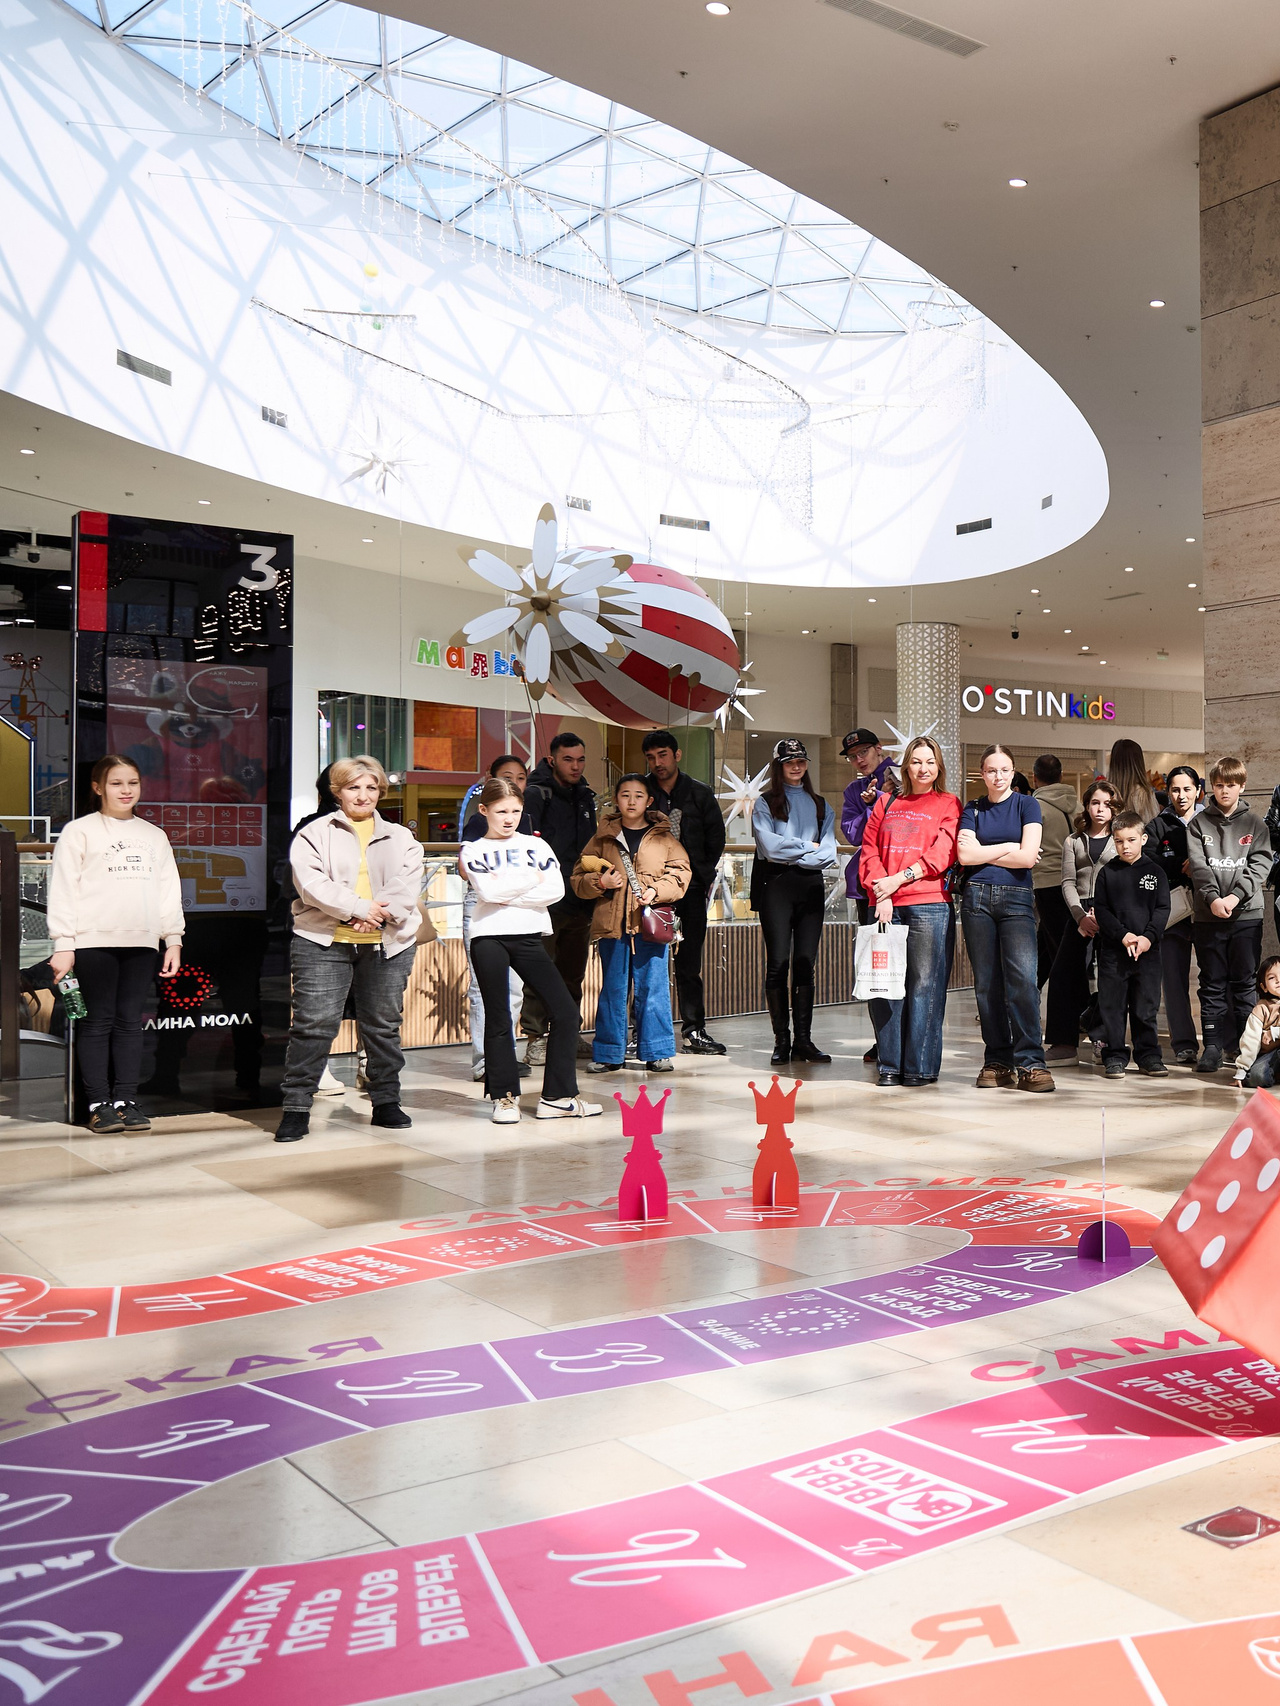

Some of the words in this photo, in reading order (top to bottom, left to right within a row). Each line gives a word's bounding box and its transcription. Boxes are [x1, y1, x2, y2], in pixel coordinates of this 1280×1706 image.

[238, 543, 279, 591] 3
[1144, 880, 1155, 890] 65
[961, 1193, 1035, 1217] СДЕЛАЙ
[265, 1265, 359, 1289] СДЕЛАЙ
[341, 1253, 418, 1275] НАЗАД
[972, 1251, 1080, 1273] 36
[859, 1293, 945, 1319] НАЗАД
[885, 1286, 974, 1313] ШАГОВ
[922, 1283, 984, 1304] ПЯТЬ
[934, 1274, 1036, 1302] СДЕЛАЙ
[698, 1318, 763, 1351] ЗАДАНИЕ
[534, 1341, 665, 1374] 33
[0, 1335, 385, 1432] СКАЯ
[335, 1369, 484, 1407] 32
[1117, 1375, 1236, 1421] СДЕЛАЙ
[1162, 1368, 1258, 1416] ЧЕТЫРЕ
[1212, 1366, 1278, 1402] ШАГА
[970, 1412, 1151, 1454] 24
[789, 1463, 892, 1506] BEBA
[829, 1453, 931, 1493] KIDS
[547, 1528, 748, 1589] 26
[346, 1567, 400, 1657] ШАГОВ
[412, 1552, 471, 1648] ВПЕРЕД
[186, 1579, 297, 1694] СДЕЛАЙ
[276, 1587, 343, 1657] ПЯТЬ
[572, 1603, 1021, 1706] НАЯ
